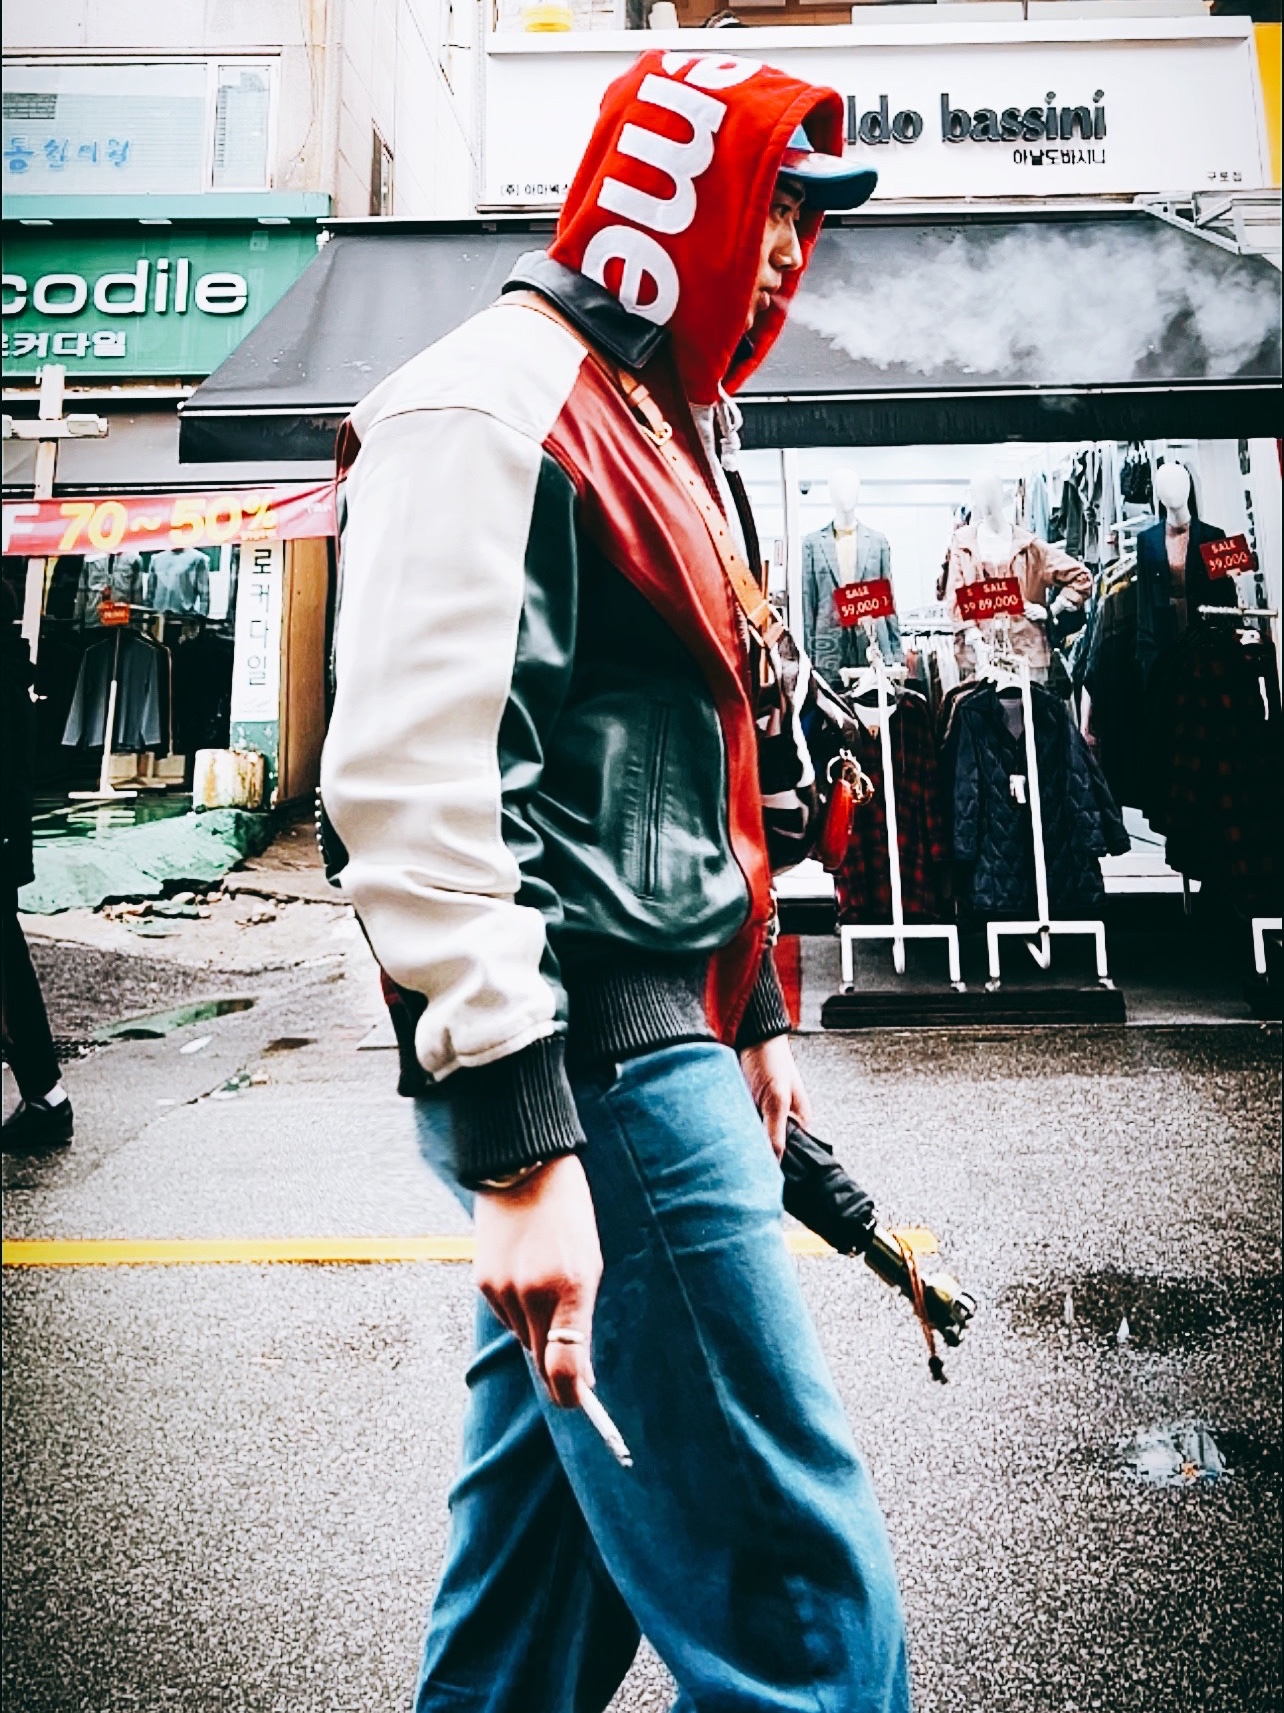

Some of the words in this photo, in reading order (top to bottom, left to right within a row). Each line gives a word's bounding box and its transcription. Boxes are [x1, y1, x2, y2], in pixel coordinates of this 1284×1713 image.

[940, 89, 1106, 143] bassini
[1013, 149, 1106, 166] 아날도바시니
[1211, 540, 1236, 554] SALE
[845, 585, 869, 599] SALE
[983, 581, 1008, 593] SALE
